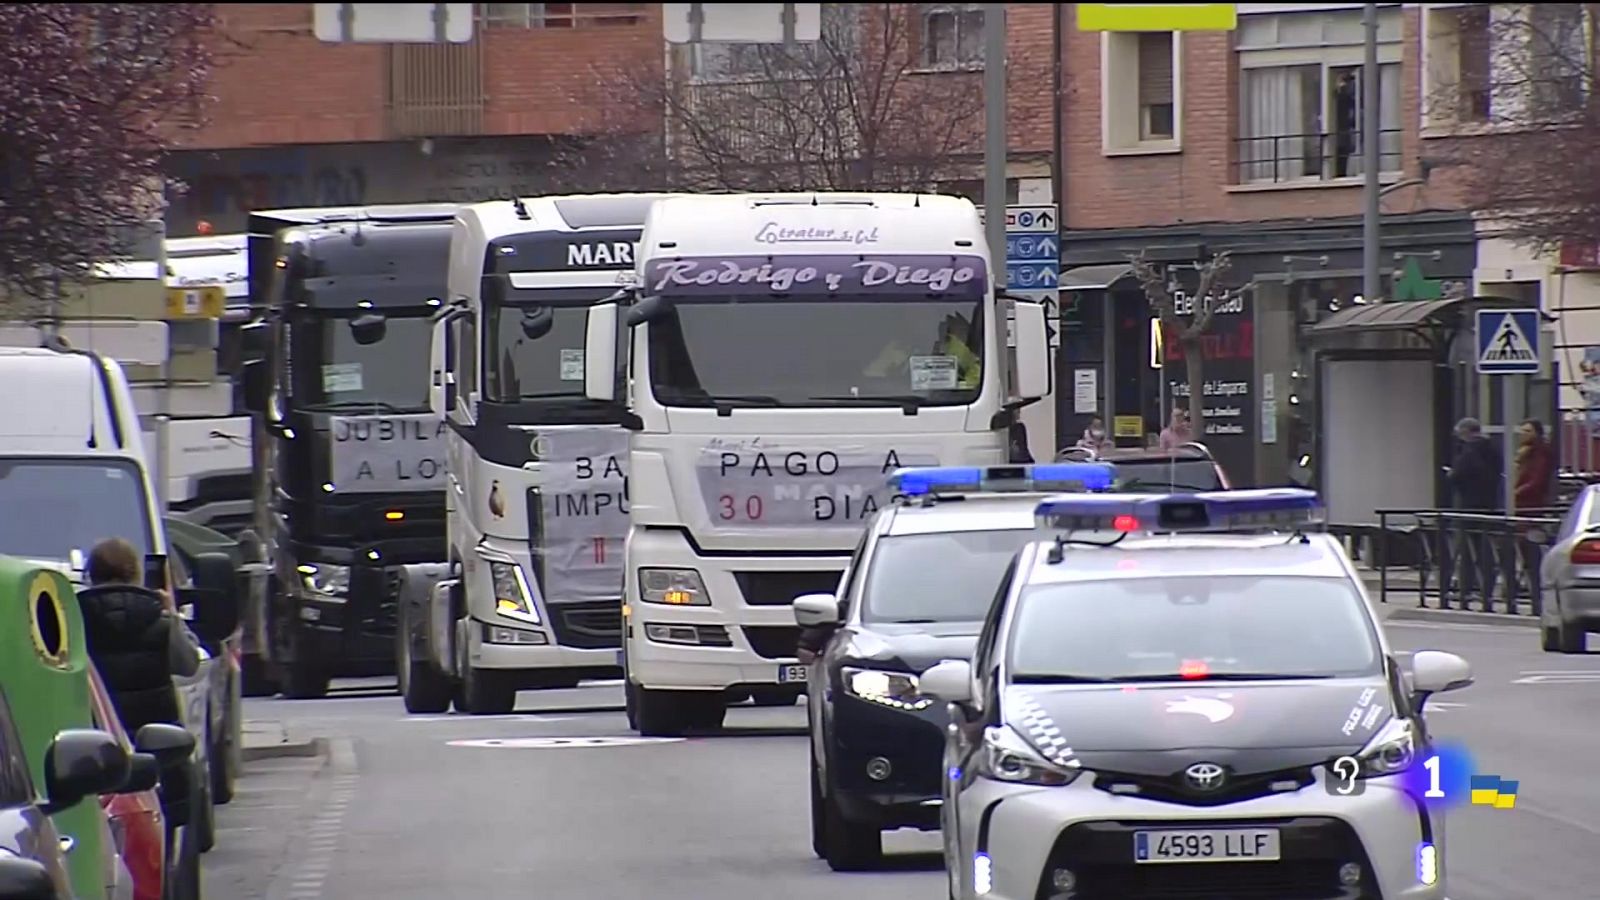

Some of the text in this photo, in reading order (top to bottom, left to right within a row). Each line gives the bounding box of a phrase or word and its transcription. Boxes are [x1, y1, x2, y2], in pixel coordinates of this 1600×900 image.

[655, 261, 817, 291] Rodrigo
[825, 272, 842, 290] y
[852, 261, 974, 291] Diego
[357, 459, 448, 480] A LO
[576, 456, 623, 479] BA
[720, 450, 902, 477] PAGO A
[719, 495, 763, 521] 30
[1157, 834, 1214, 857] 4593
[1225, 834, 1269, 856] LLF
